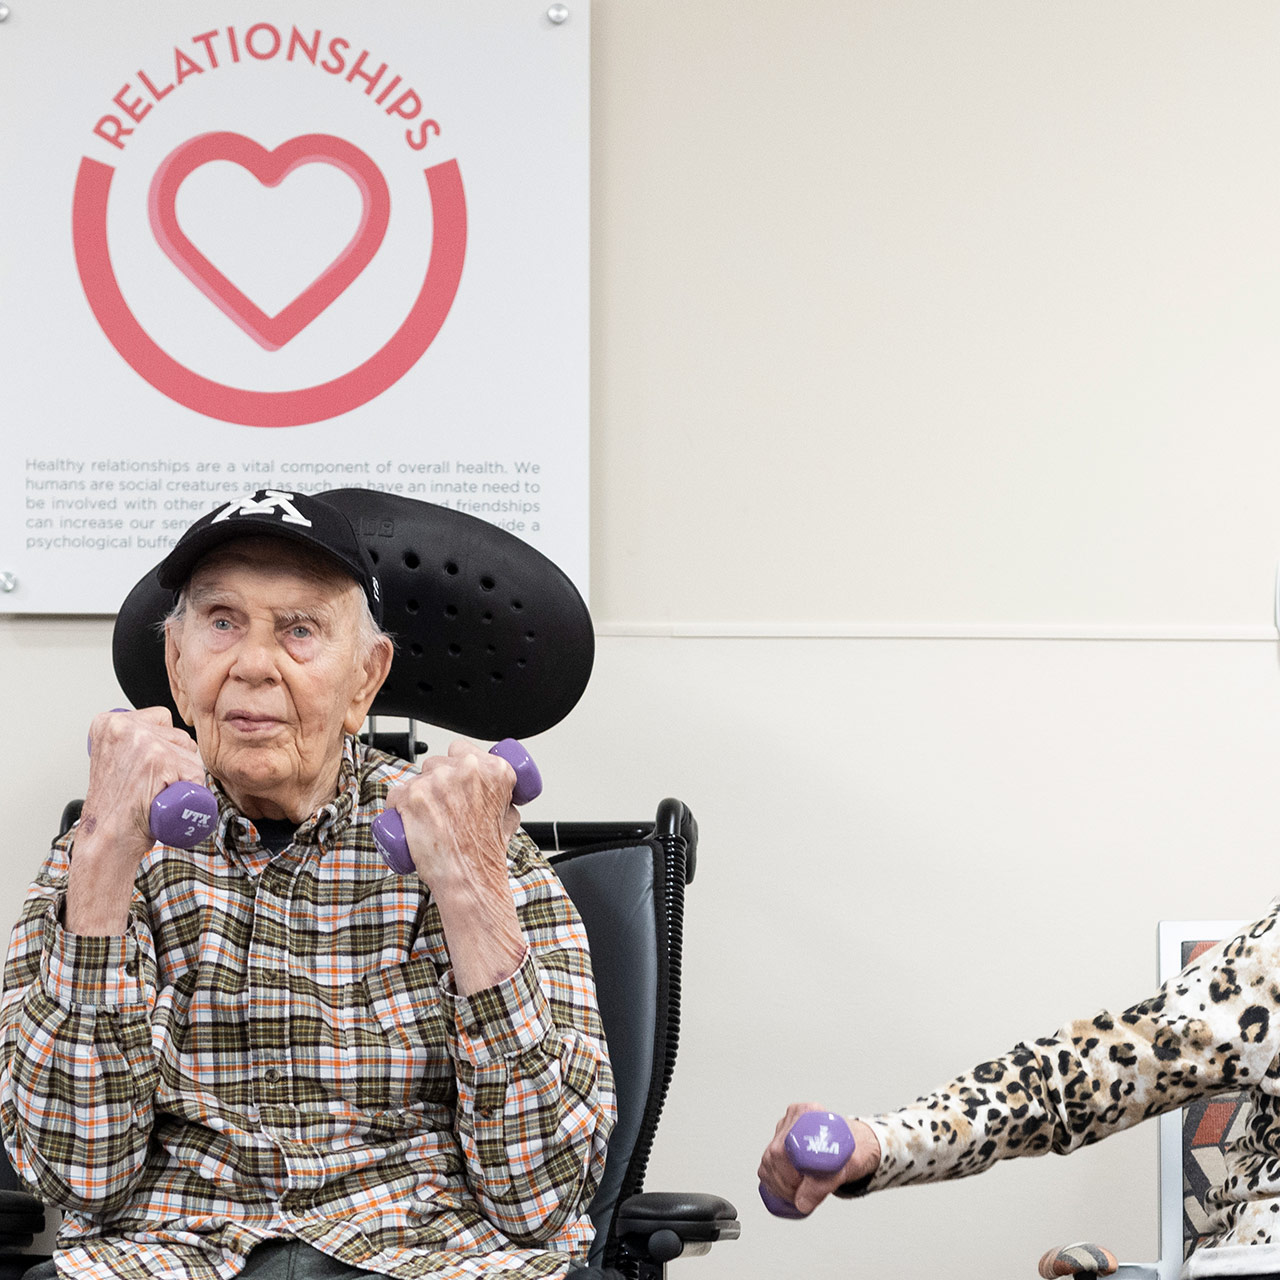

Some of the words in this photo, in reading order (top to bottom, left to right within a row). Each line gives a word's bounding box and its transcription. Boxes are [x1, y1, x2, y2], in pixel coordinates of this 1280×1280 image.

[93, 22, 441, 151] RELATIONSHIPS
[26, 459, 85, 473] Healthy
[91, 459, 190, 473] relationships
[196, 462, 221, 472] are
[227, 463, 236, 472] a
[242, 460, 274, 473] vital
[280, 462, 370, 475] component
[376, 461, 392, 473] of
[398, 462, 450, 474] overall
[456, 462, 507, 474] health.
[514, 462, 540, 474] We
[26, 478, 86, 490] humans
[90, 481, 114, 490] are
[119, 479, 162, 491] social
[166, 480, 239, 492] creatures
[407, 483, 426, 493] an
[431, 482, 478, 493] innate
[482, 481, 520, 493] need
[524, 482, 540, 493] to
[26, 497, 45, 509] be
[52, 497, 117, 510] involved
[124, 498, 157, 510] with
[164, 498, 205, 510] other
[456, 499, 541, 514] friendships
[26, 518, 53, 528] can
[60, 519, 123, 529] increase
[129, 519, 155, 529] our
[161, 519, 196, 529] sens
[531, 522, 540, 532] a
[26, 536, 132, 550] psychological
[137, 535, 177, 548] buffe
[181, 808, 211, 825] VTX
[185, 826, 195, 837] 2
